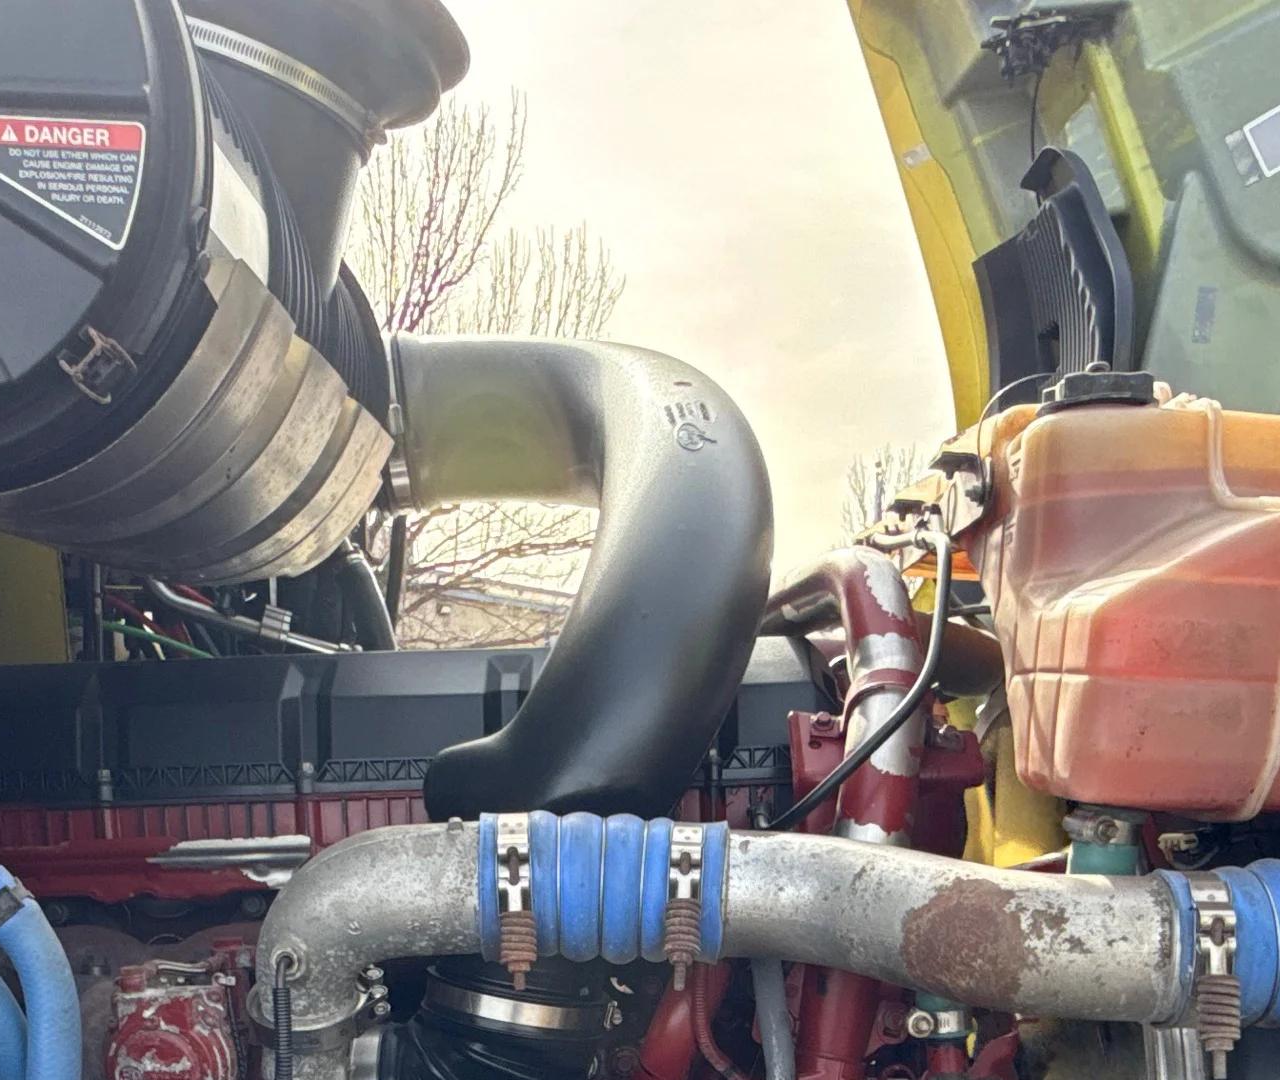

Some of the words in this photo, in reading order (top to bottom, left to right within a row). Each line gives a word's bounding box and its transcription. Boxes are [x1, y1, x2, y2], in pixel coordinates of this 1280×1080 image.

[24, 124, 110, 147] DANGER
[8, 148, 22, 157] DO
[23, 149, 40, 158] NOT
[42, 150, 59, 159] USE
[61, 150, 89, 160] ETHER
[90, 151, 118, 161] WHICH
[119, 153, 138, 162] CAN
[22, 159, 51, 169] CAUSE
[53, 161, 83, 170] ENGINE
[85, 163, 121, 172] DAMAGE
[122, 164, 136, 173] OR
[87, 173, 134, 184] RESULTING
[37, 182, 47, 190] IN
[48, 183, 84, 192] SERIOUS
[85, 184, 130, 194] PERSONAL
[50, 193, 81, 203] INJURY
[82, 195, 95, 203] OR
